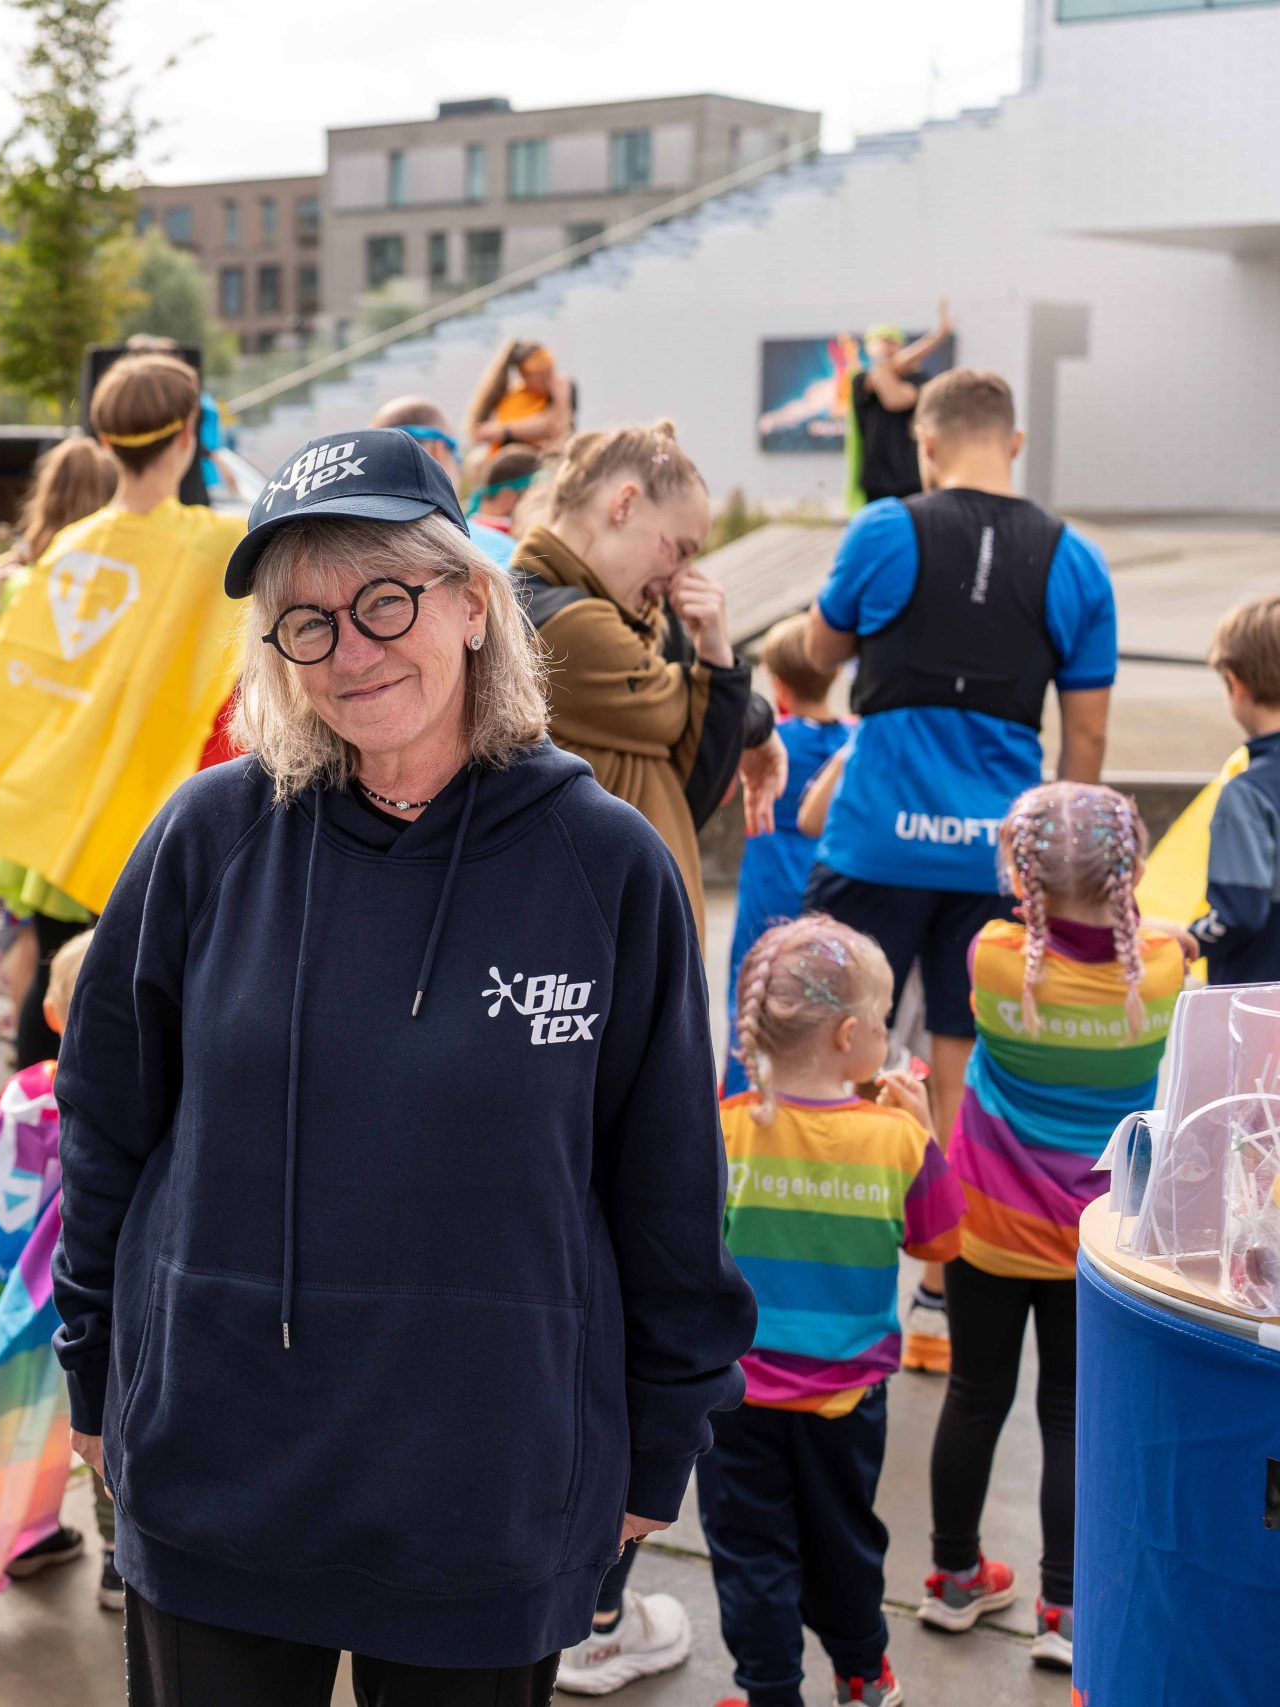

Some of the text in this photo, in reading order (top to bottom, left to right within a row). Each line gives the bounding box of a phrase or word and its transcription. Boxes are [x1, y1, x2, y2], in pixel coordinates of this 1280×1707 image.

[289, 441, 356, 487] Bio
[295, 457, 368, 500] tex
[524, 974, 593, 1015] Bio
[530, 1014, 600, 1046] tex
